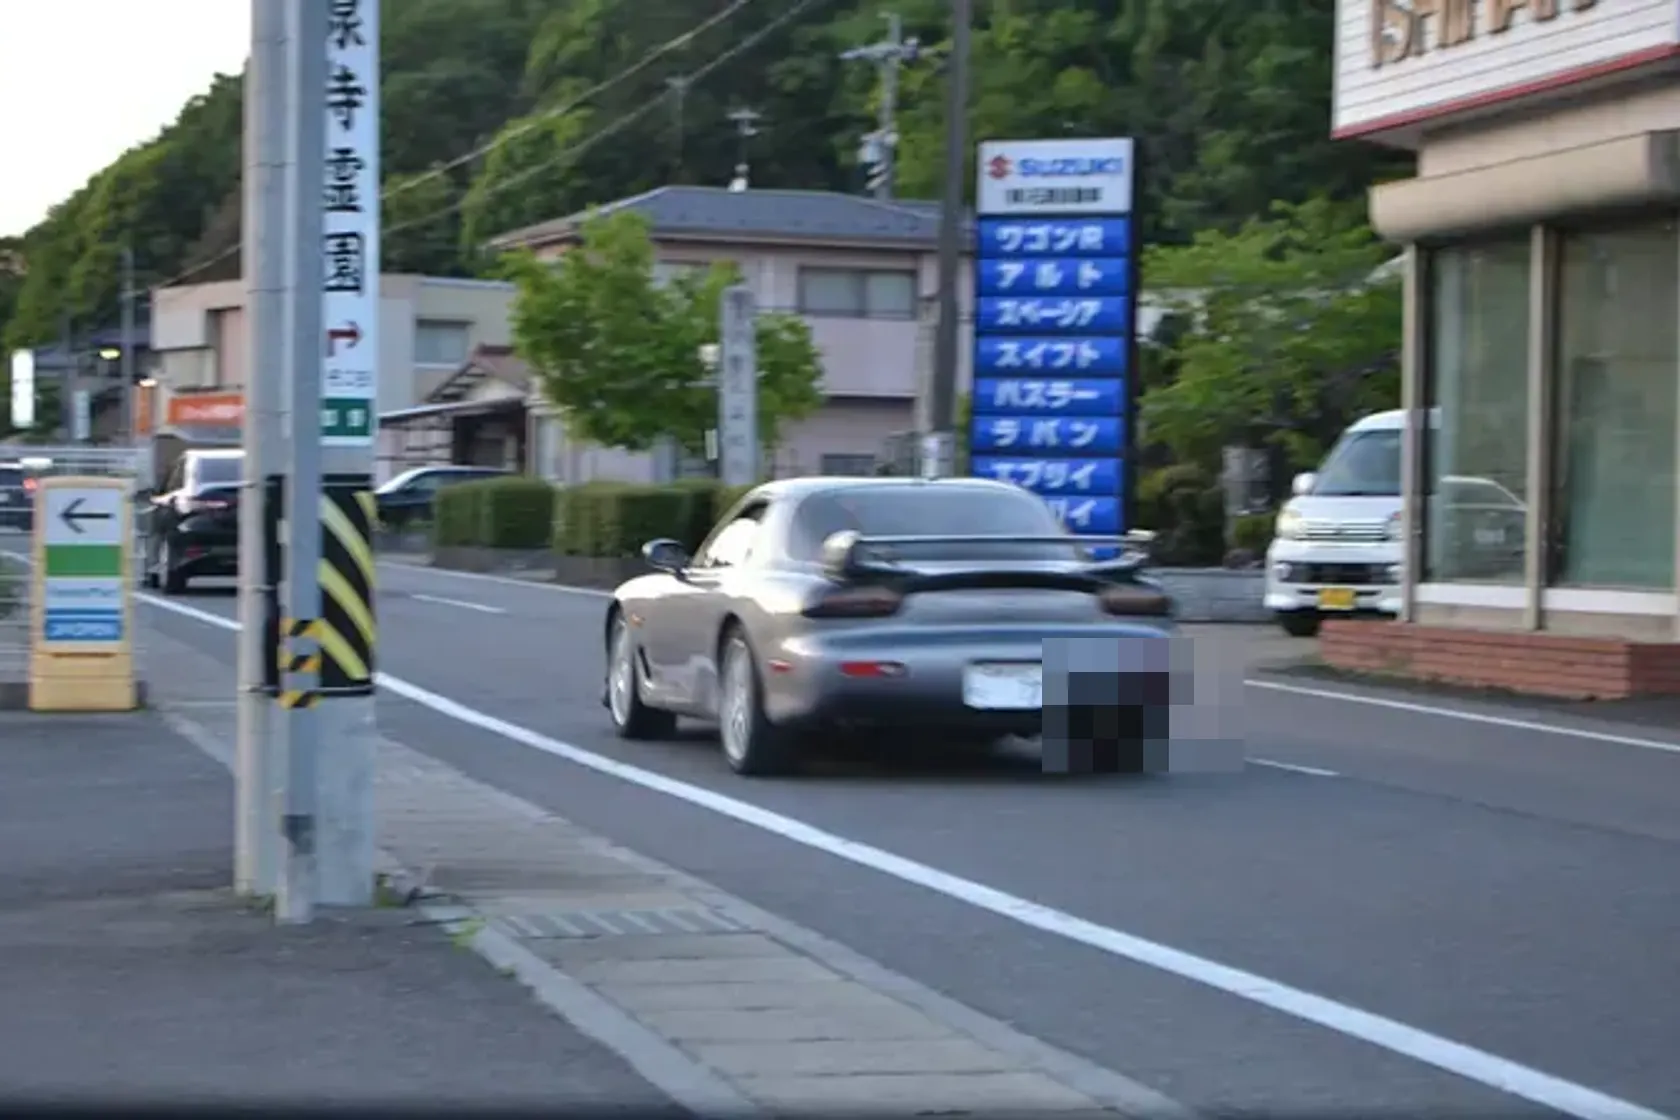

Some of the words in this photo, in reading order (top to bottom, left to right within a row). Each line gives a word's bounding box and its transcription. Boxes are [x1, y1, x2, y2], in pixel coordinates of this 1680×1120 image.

[1021, 158, 1123, 178] SUZUKI
[994, 224, 1104, 252] ワゴンR
[996, 261, 1103, 290] アルト
[994, 341, 1101, 369] スイフト
[993, 382, 1099, 409] ハスラー
